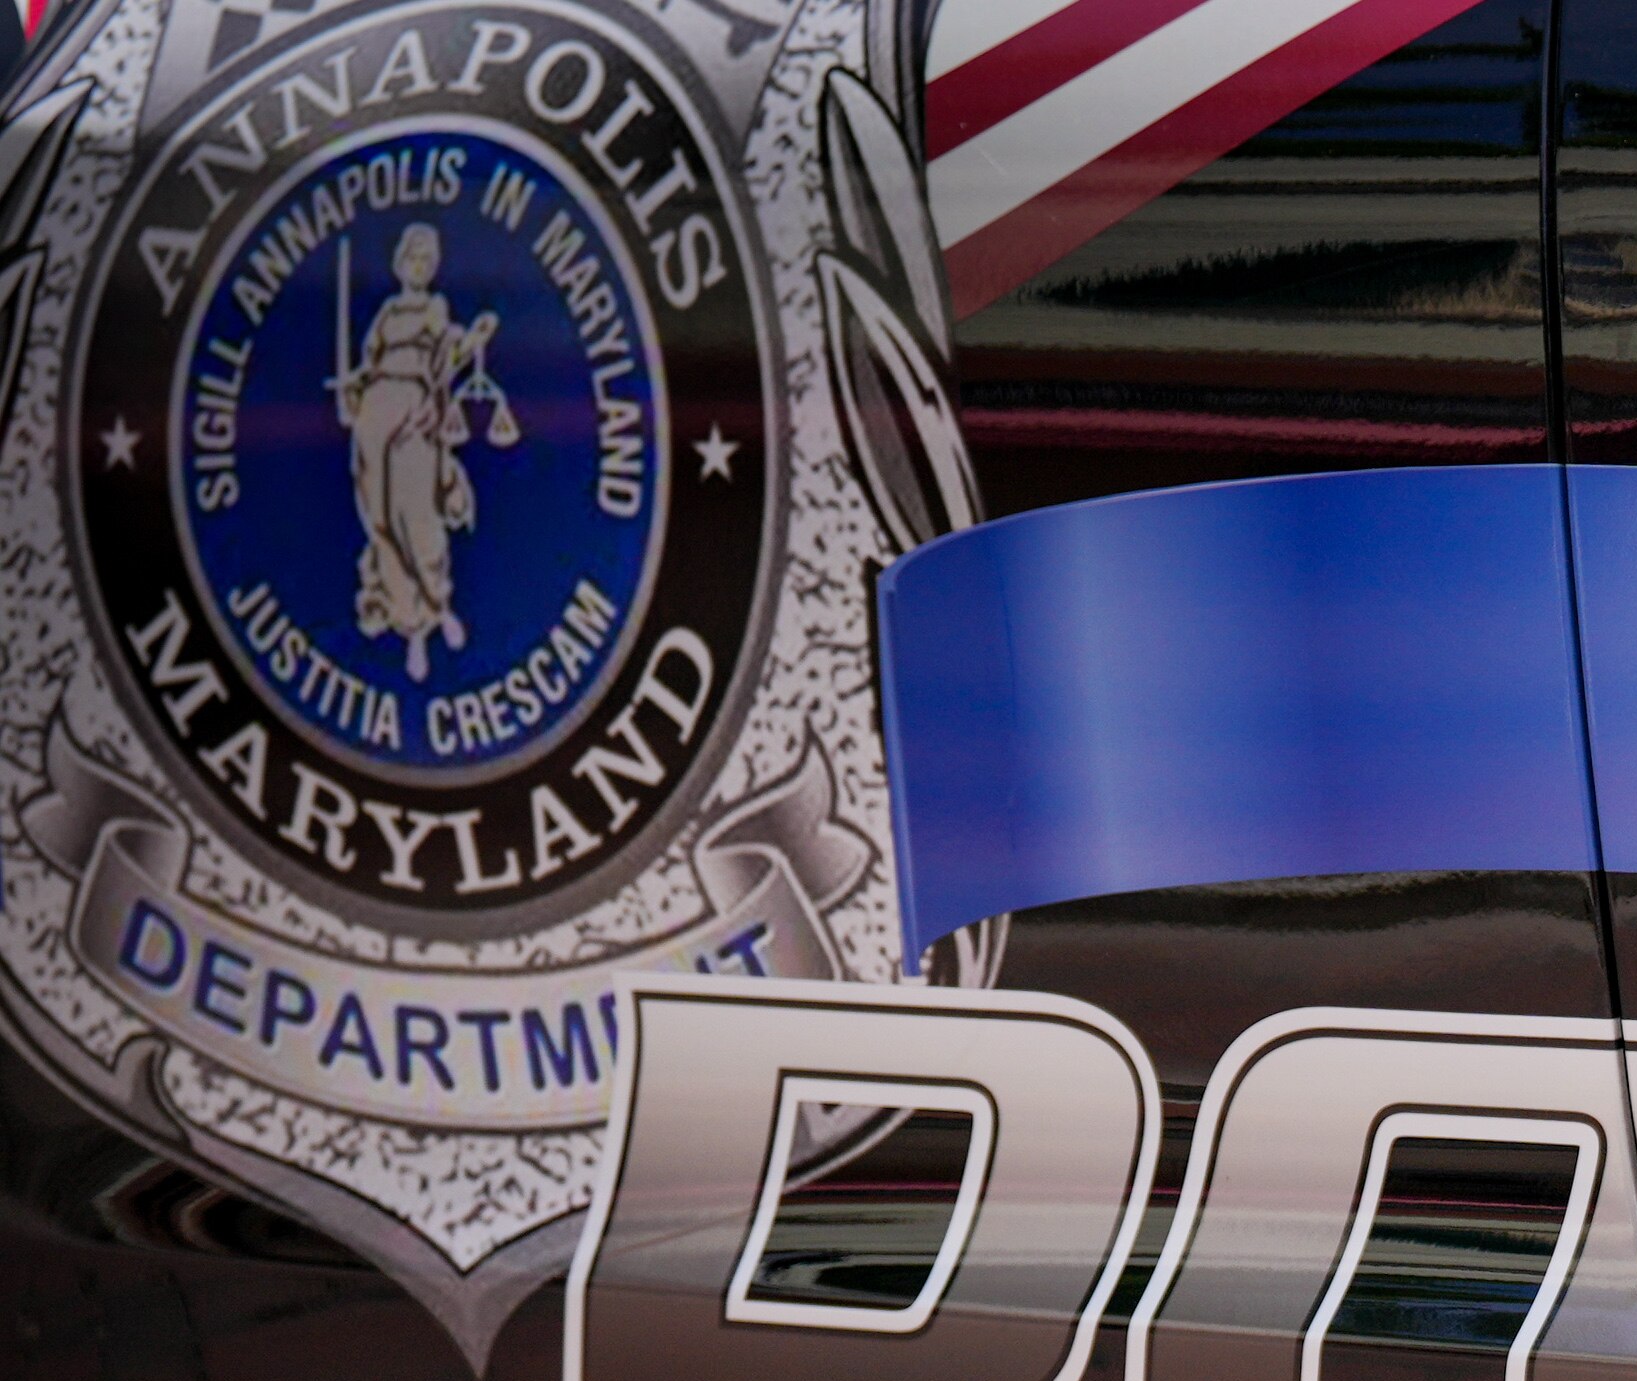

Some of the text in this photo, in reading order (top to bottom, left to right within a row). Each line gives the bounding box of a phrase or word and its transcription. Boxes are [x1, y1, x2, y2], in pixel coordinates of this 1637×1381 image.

[138, 19, 726, 316] ANNAPOLIS
[193, 147, 643, 519] SIGILL ANNAPOLIS IN MARYLAND
[126, 590, 716, 894] MARYLAND
[228, 578, 618, 756] JUSTITIA CRESCAM
[117, 898, 770, 1092] DEPARTMT
